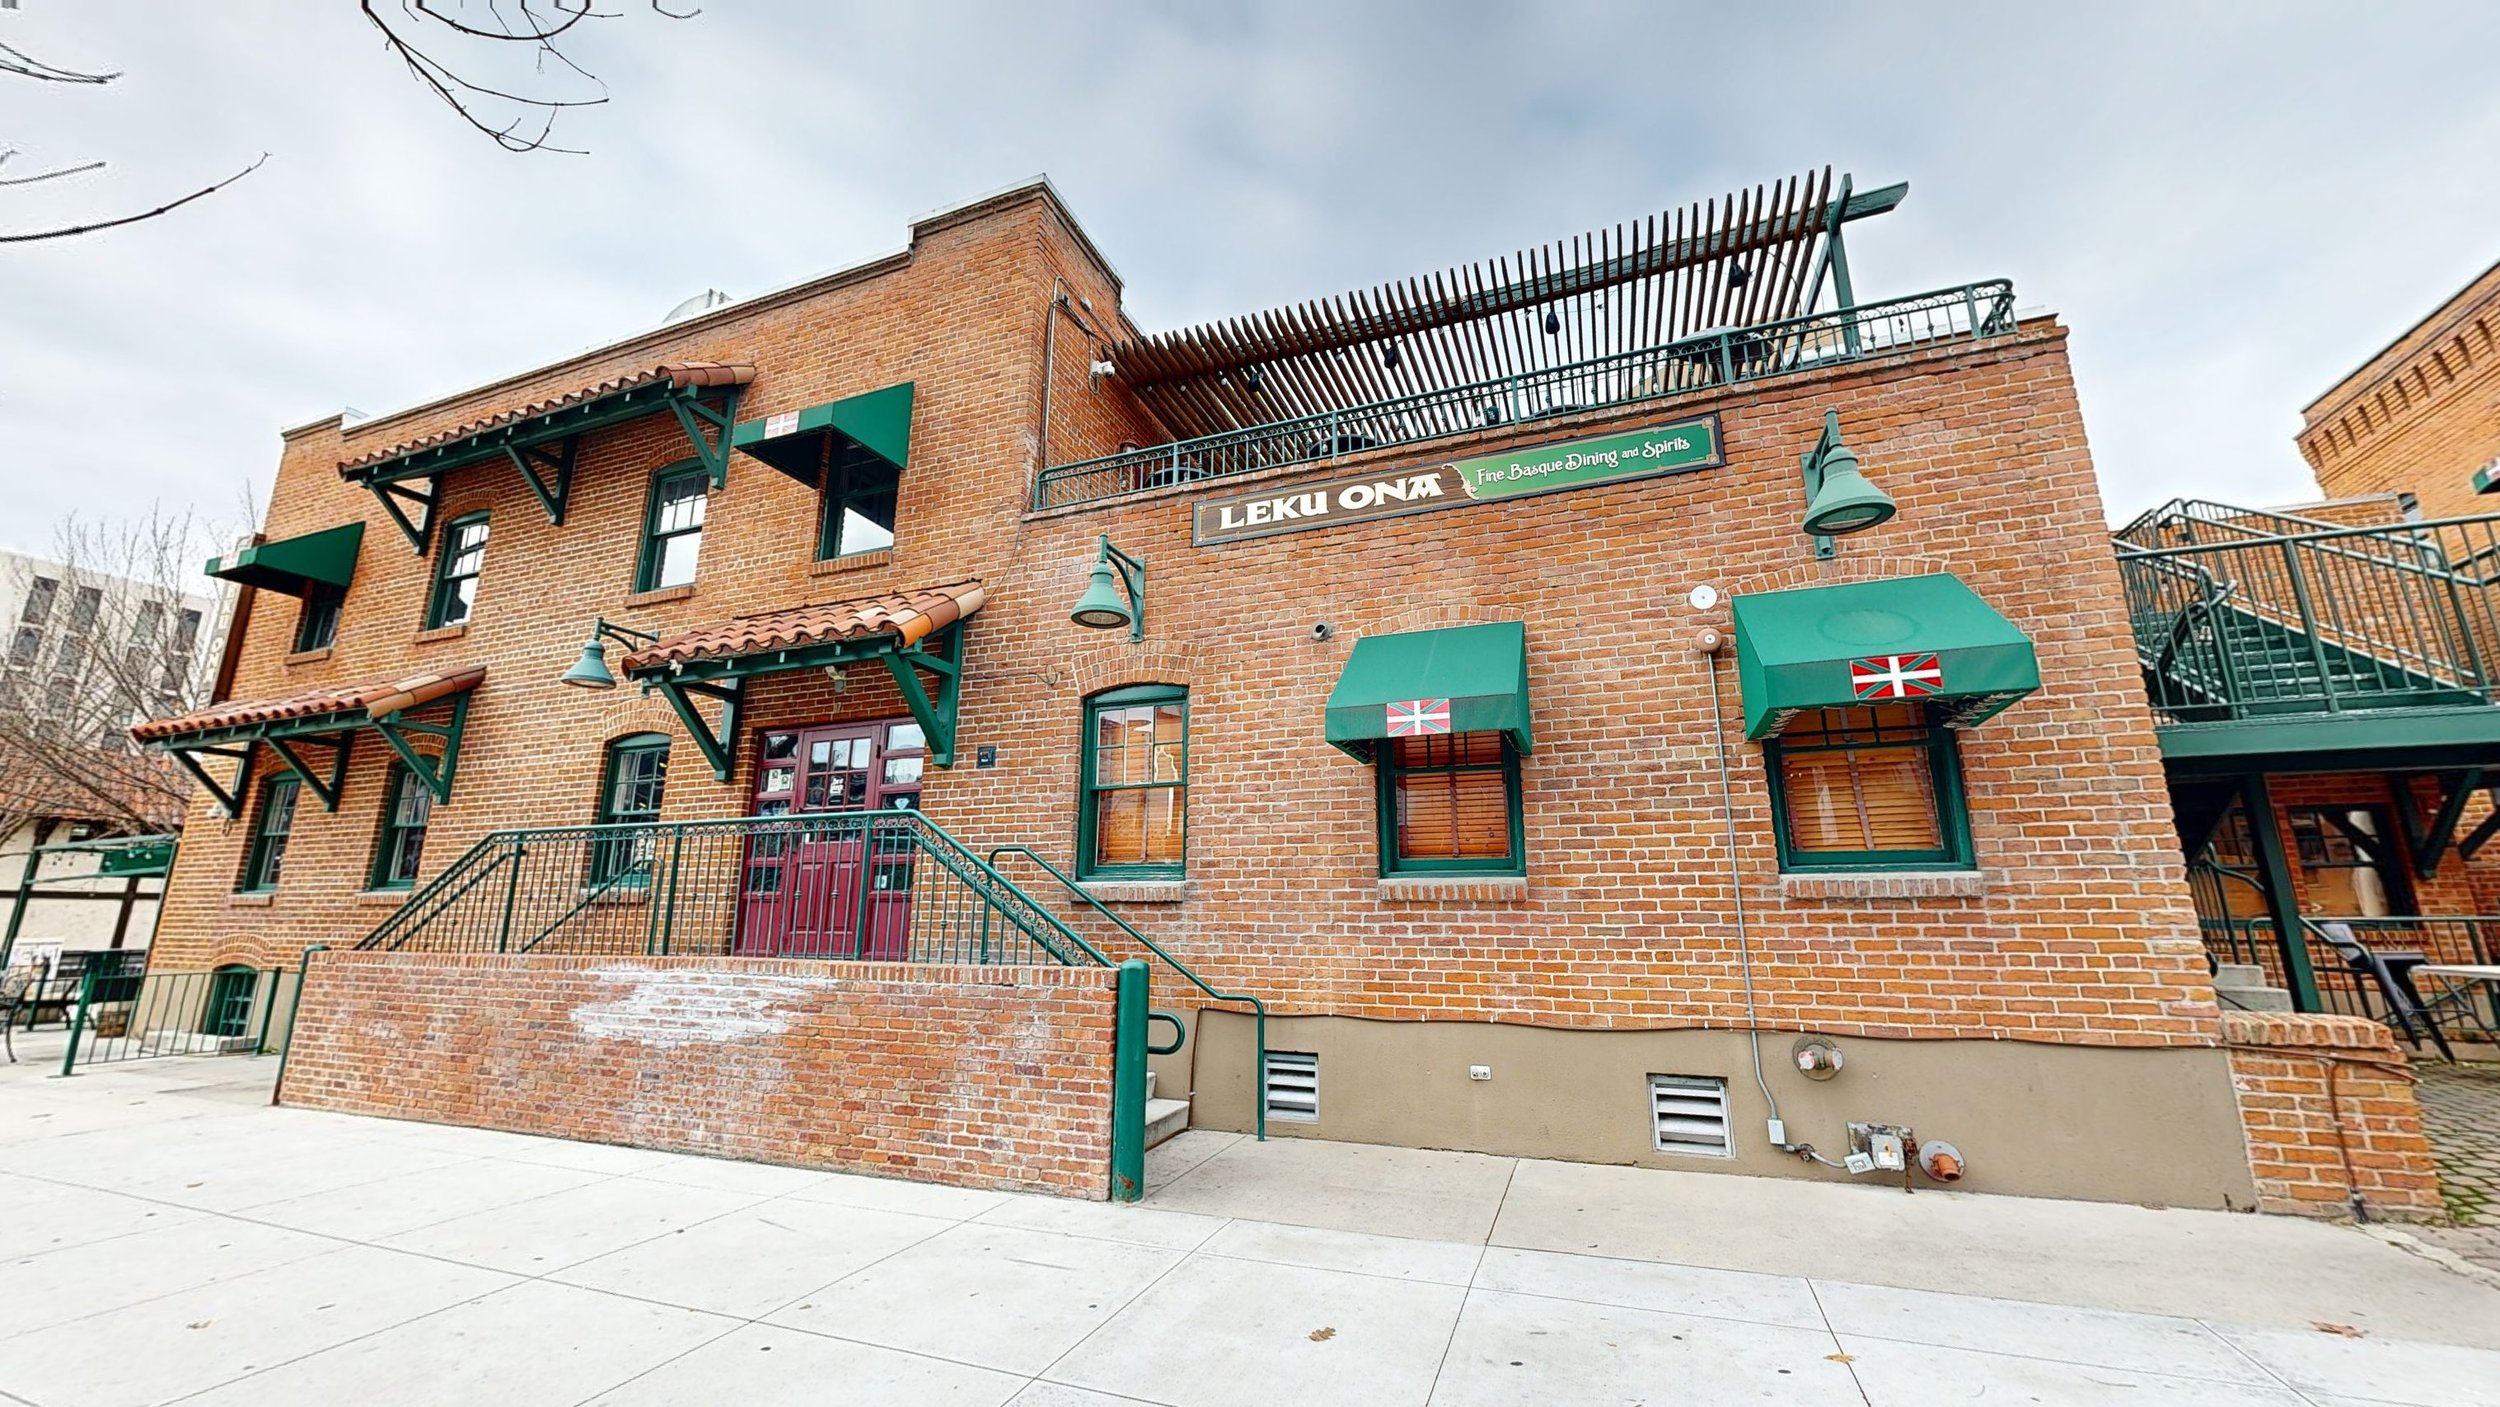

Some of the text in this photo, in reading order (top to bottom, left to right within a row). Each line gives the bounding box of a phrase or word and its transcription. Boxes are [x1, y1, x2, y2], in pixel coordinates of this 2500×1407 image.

[1476, 436, 1691, 486] Fine Basque Dining and Spirits
[1219, 472, 1445, 530] LEKU ONA
